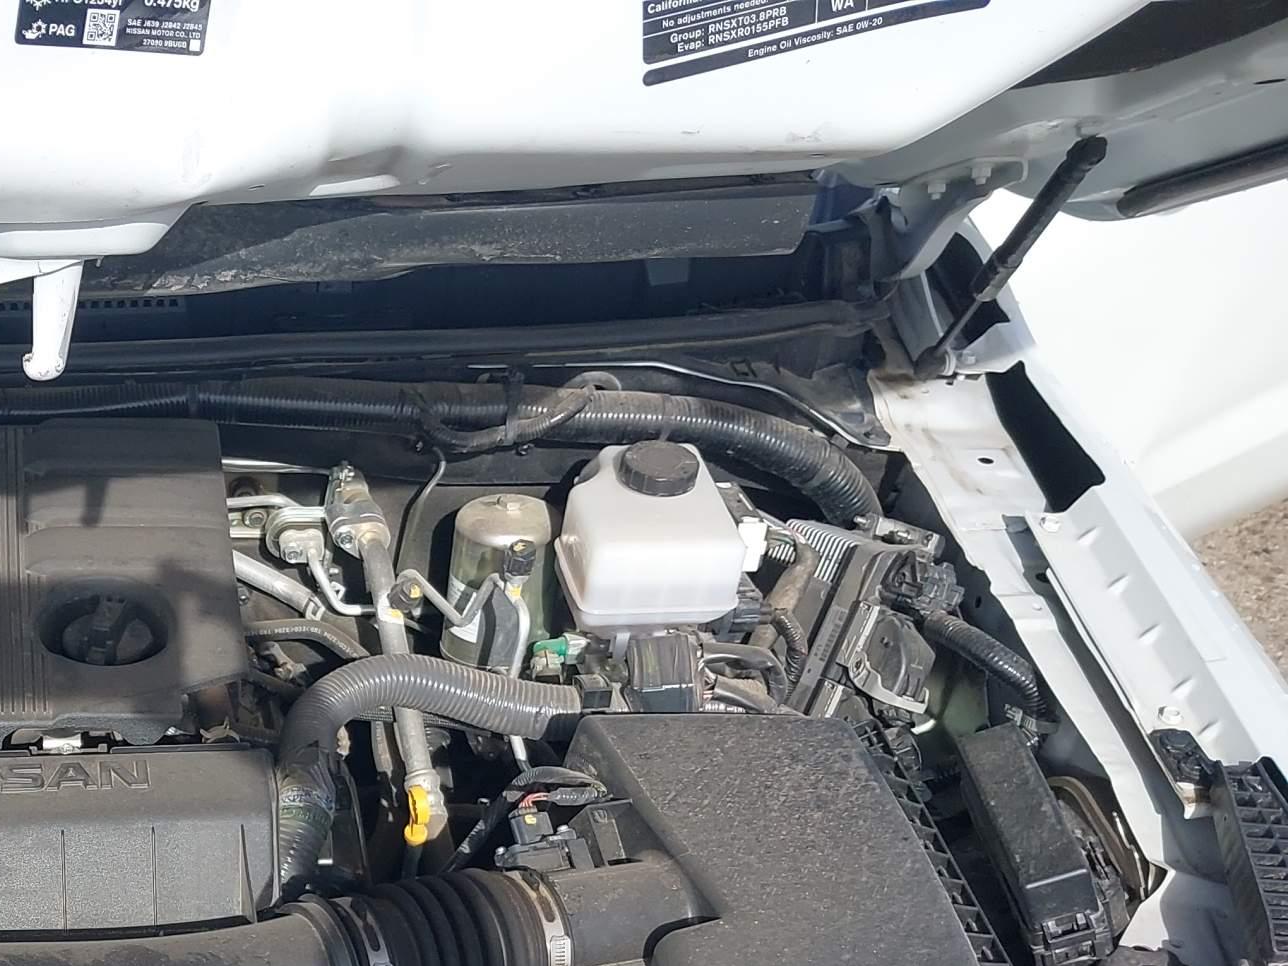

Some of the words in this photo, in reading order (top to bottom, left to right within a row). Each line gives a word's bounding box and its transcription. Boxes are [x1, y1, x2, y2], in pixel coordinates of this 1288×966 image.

[145, 0, 200, 13] 0.475kg
[831, 0, 855, 12] WA
[127, 18, 143, 26] SAE
[662, 19, 675, 29] No
[677, 7, 731, 25] adjustments
[670, 29, 705, 44] Group:
[708, 6, 787, 34] RNSXT03.8PRB
[48, 23, 76, 37] PAG
[126, 27, 150, 35] NISSAN
[677, 39, 705, 53] Evap:
[708, 17, 789, 45] RNSXR0155PFB
[748, 45, 777, 58] Engine
[779, 40, 792, 50] Oil
[794, 30, 834, 46] Viscosity:
[836, 23, 854, 36] SAE
[856, 17, 883, 30] 0W-20
